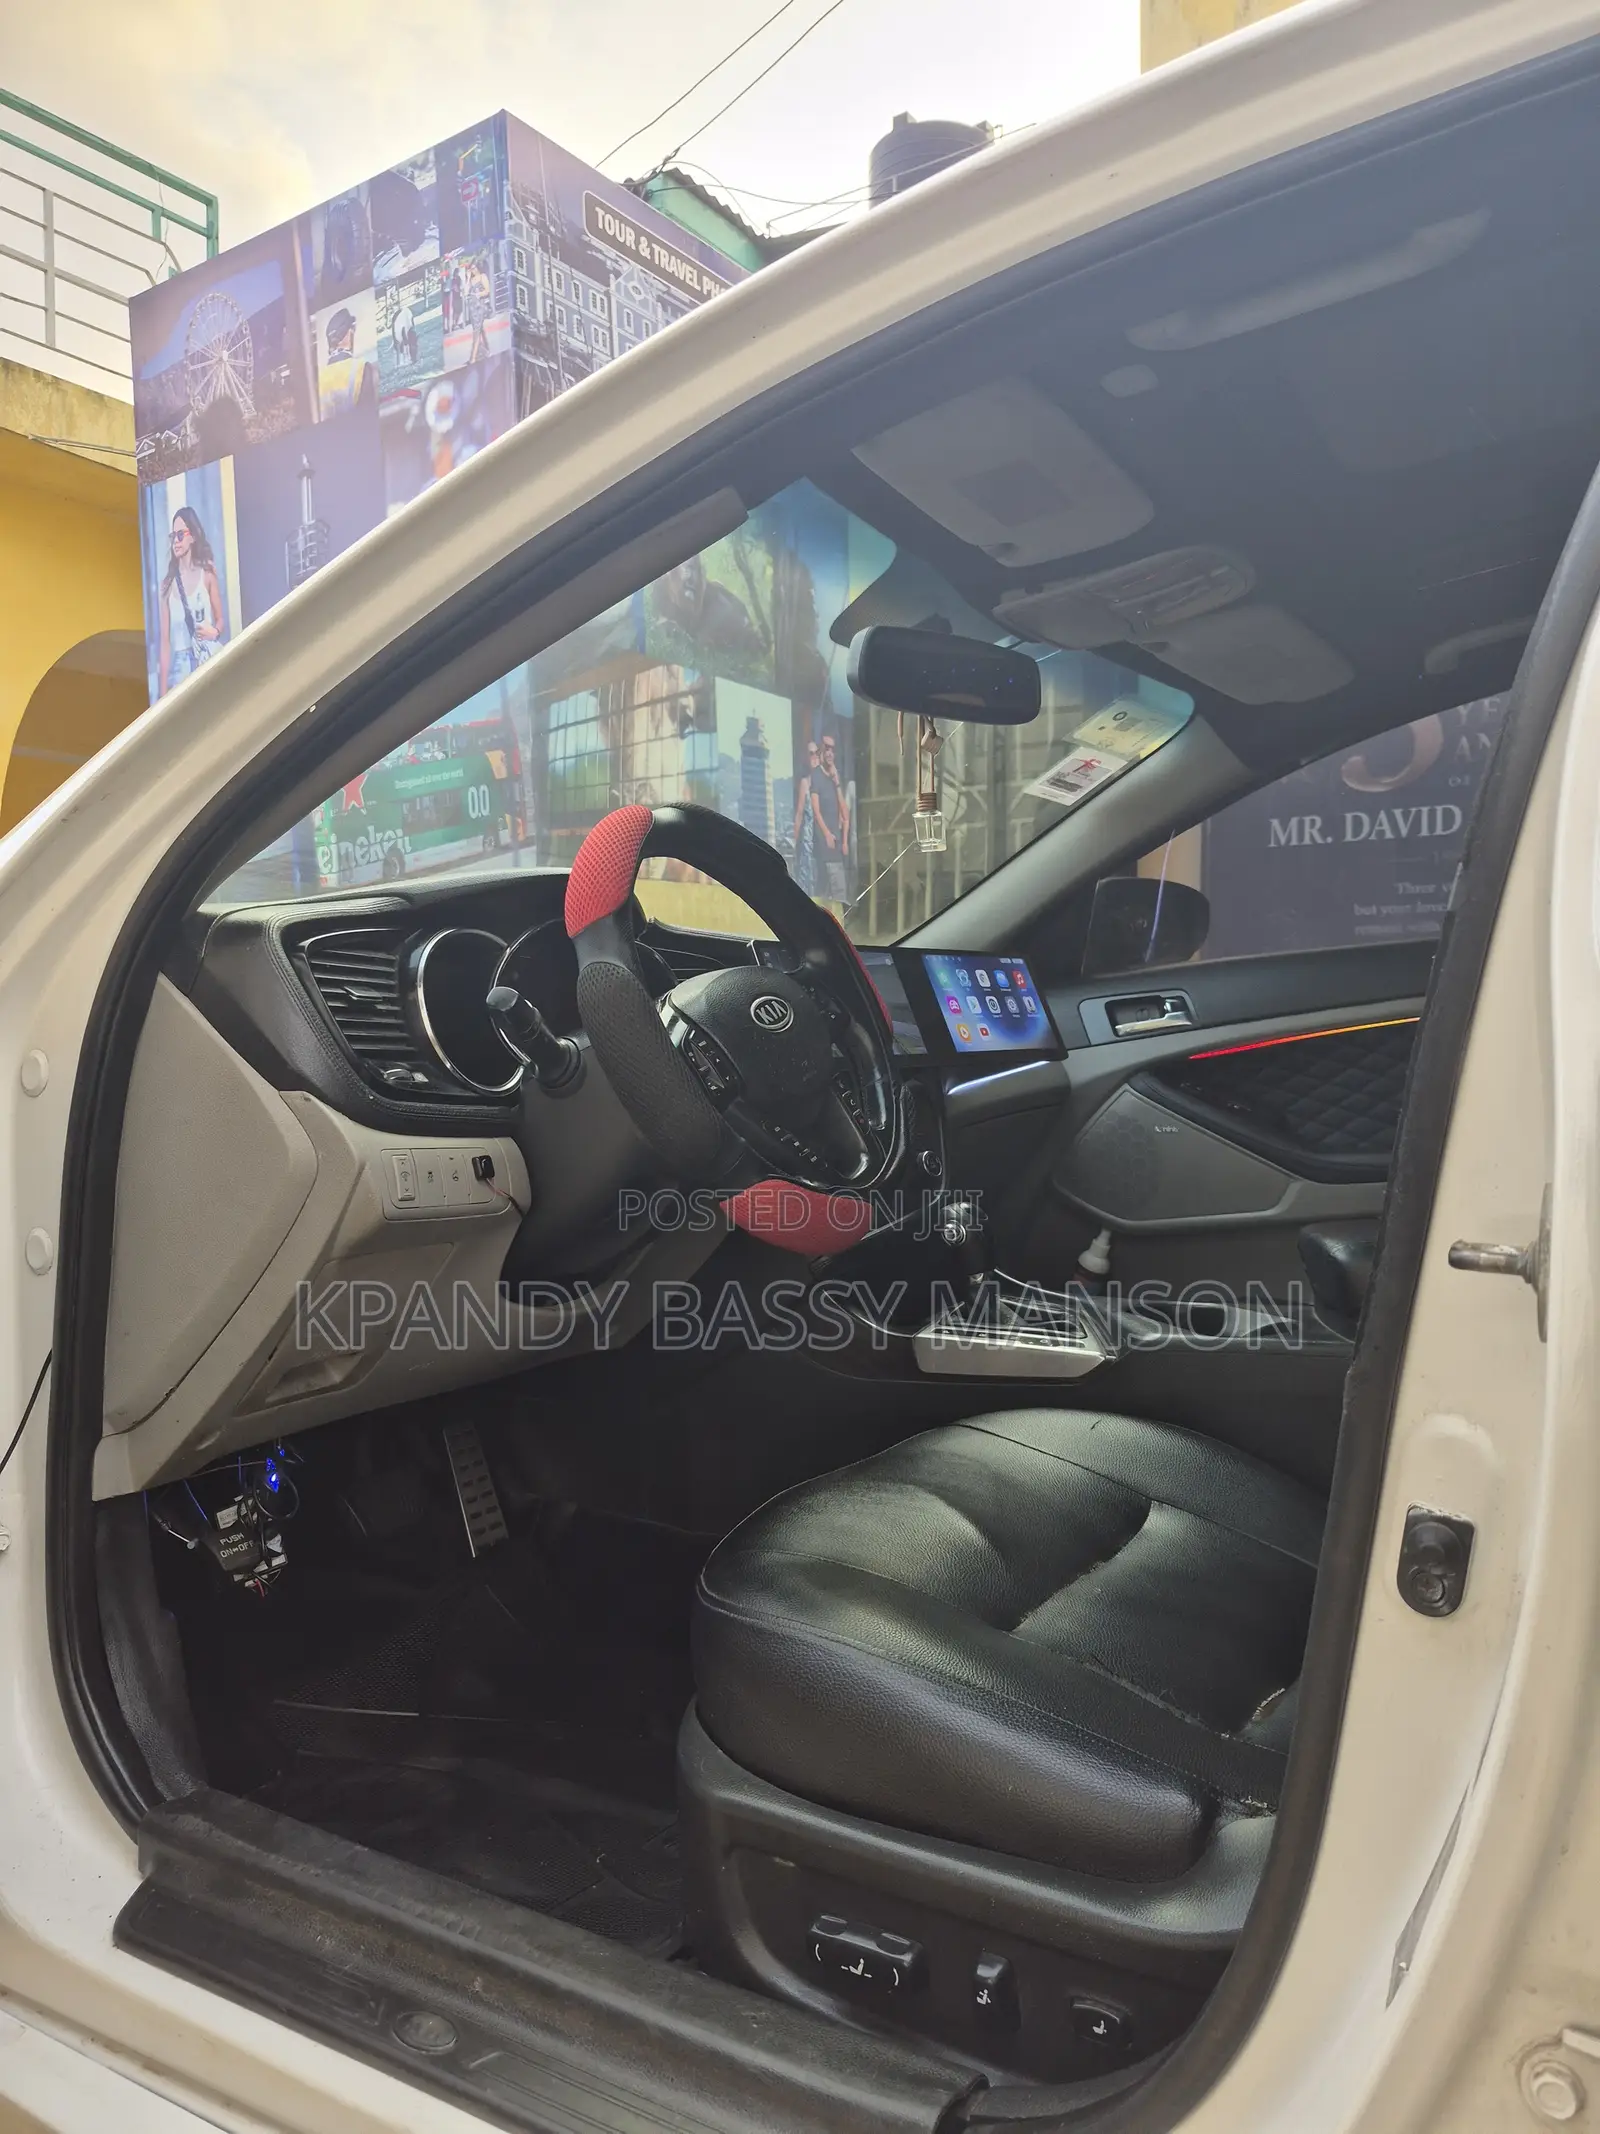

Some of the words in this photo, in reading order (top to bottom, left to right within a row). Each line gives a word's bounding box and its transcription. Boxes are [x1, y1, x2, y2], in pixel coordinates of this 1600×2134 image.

[595, 206, 636, 250] TOUR
[638, 235, 651, 260] &
[652, 243, 701, 291] TRAVEL
[1267, 816, 1333, 847] MR.
[1343, 804, 1462, 842] DAVID
[317, 825, 412, 874] eineken
[755, 1000, 788, 1025] KIA
[220, 1532, 245, 1546] PUSH
